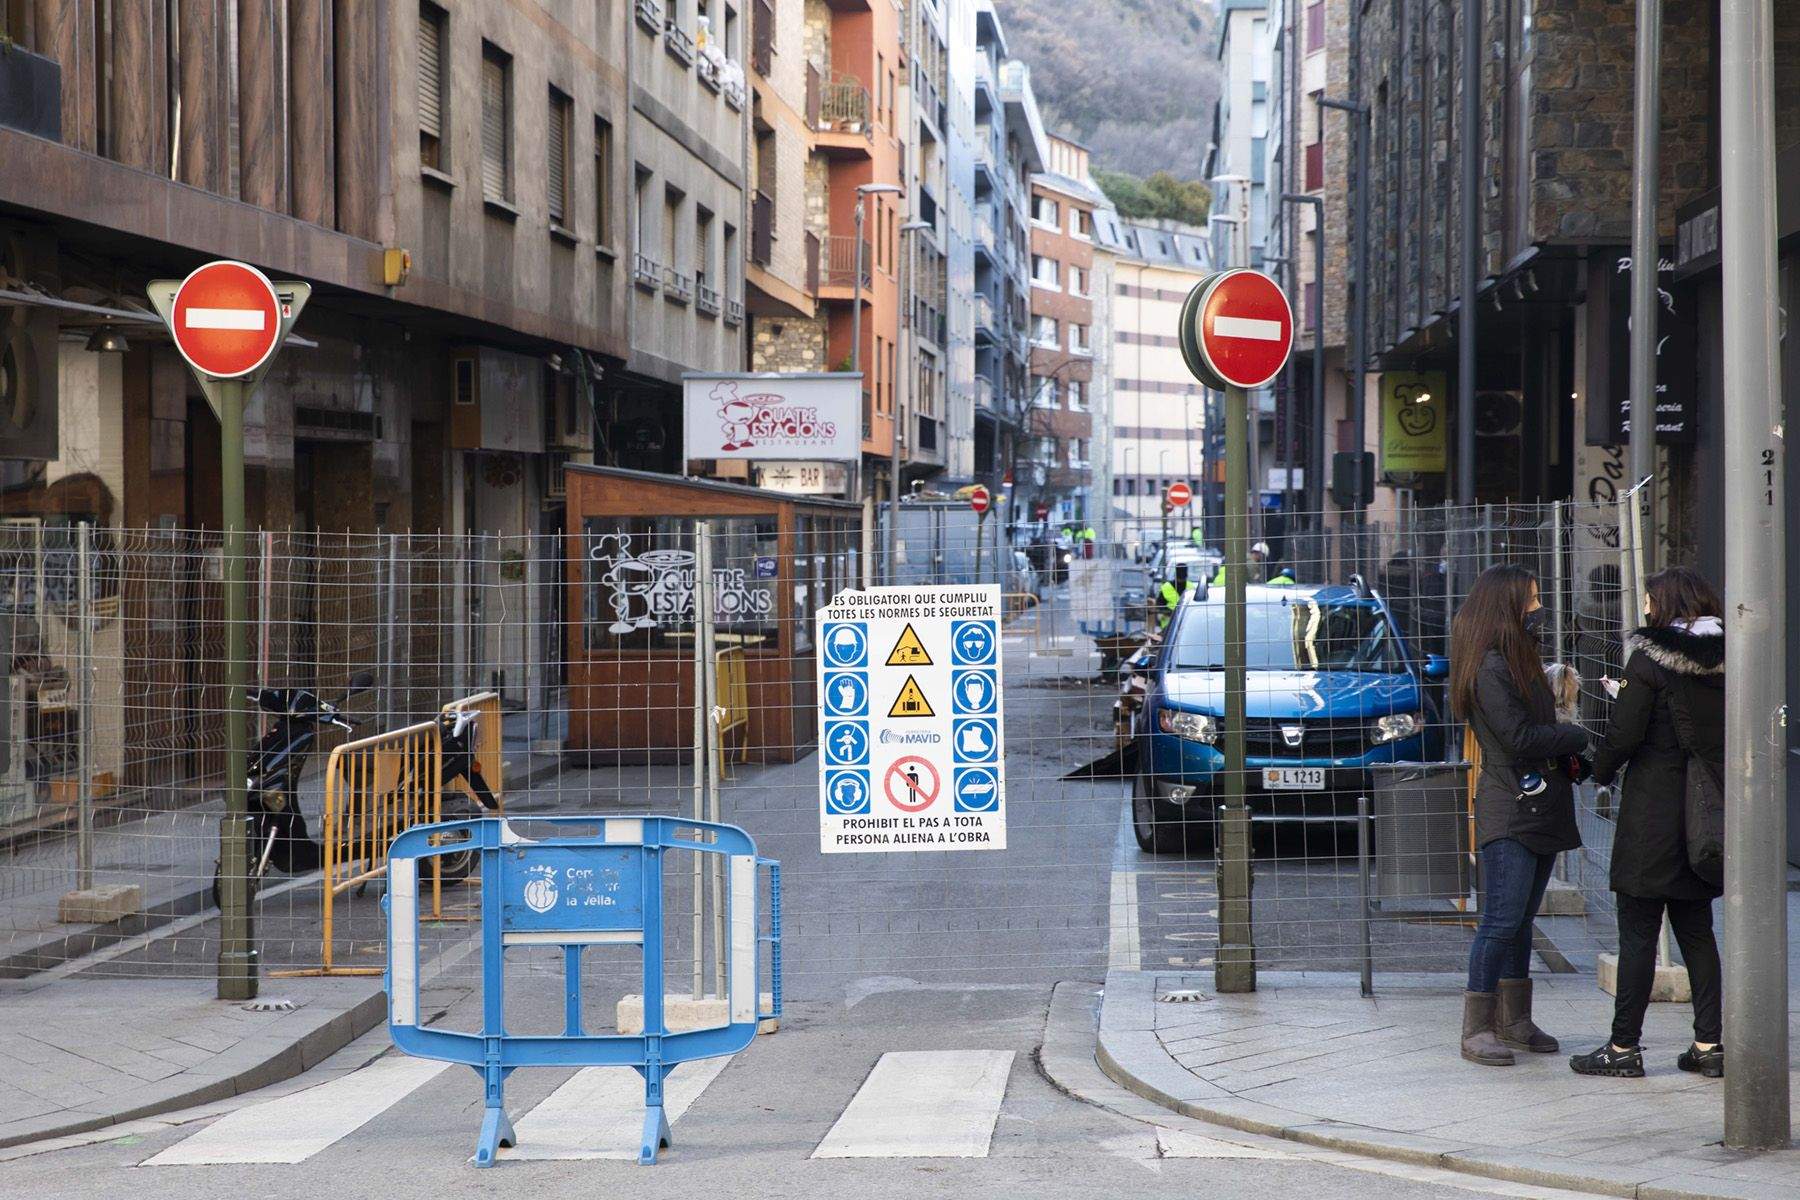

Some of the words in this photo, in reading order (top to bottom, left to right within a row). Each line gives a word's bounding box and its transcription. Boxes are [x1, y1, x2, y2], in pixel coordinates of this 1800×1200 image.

[758, 408, 817, 423] QUATRE
[751, 422, 836, 439] ESTACIONS
[800, 468, 820, 487] BAR
[662, 569, 745, 592] QUTRE
[652, 590, 772, 613] ESTAIONS
[848, 594, 911, 606] OBLIGATORI
[915, 594, 936, 604] QUE
[940, 593, 987, 604] CUMPLIU
[828, 609, 856, 620] TOTES
[860, 608, 875, 619] LES
[879, 608, 920, 618] NORMES
[923, 607, 936, 617] DE
[939, 606, 994, 617] SEGURETAT
[905, 734, 942, 744] MAVID
[1283, 771, 1290, 783] L
[1294, 770, 1321, 783] 1213
[843, 818, 899, 829] PROHIBIT
[903, 818, 915, 828] EL
[919, 817, 939, 828] PAS
[943, 817, 951, 827] A
[954, 817, 983, 827] TOTA
[836, 834, 890, 845] PERSONA
[893, 833, 935, 844] ALIENA
[938, 833, 946, 843] A
[949, 832, 990, 843] L'OBRA
